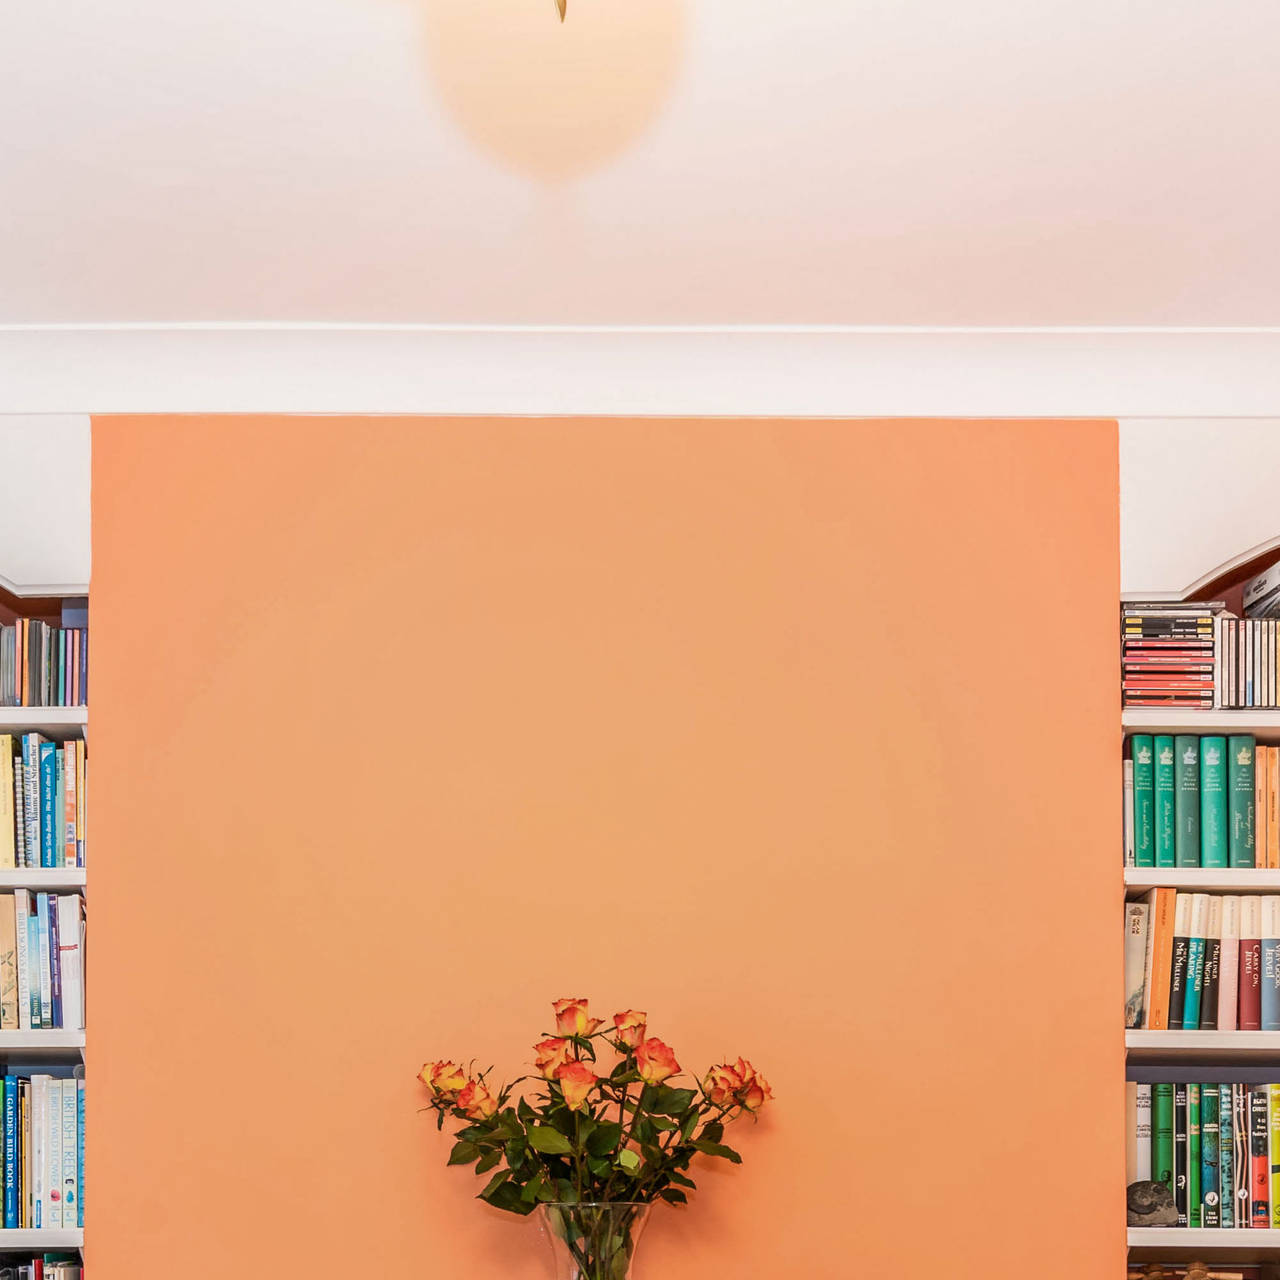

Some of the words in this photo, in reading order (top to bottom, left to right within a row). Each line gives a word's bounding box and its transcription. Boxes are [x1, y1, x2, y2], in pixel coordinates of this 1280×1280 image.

[1204, 962, 1212, 986] NIGHTS
[64, 1096, 75, 1139] BRITISH
[64, 1144, 75, 1178] TREES
